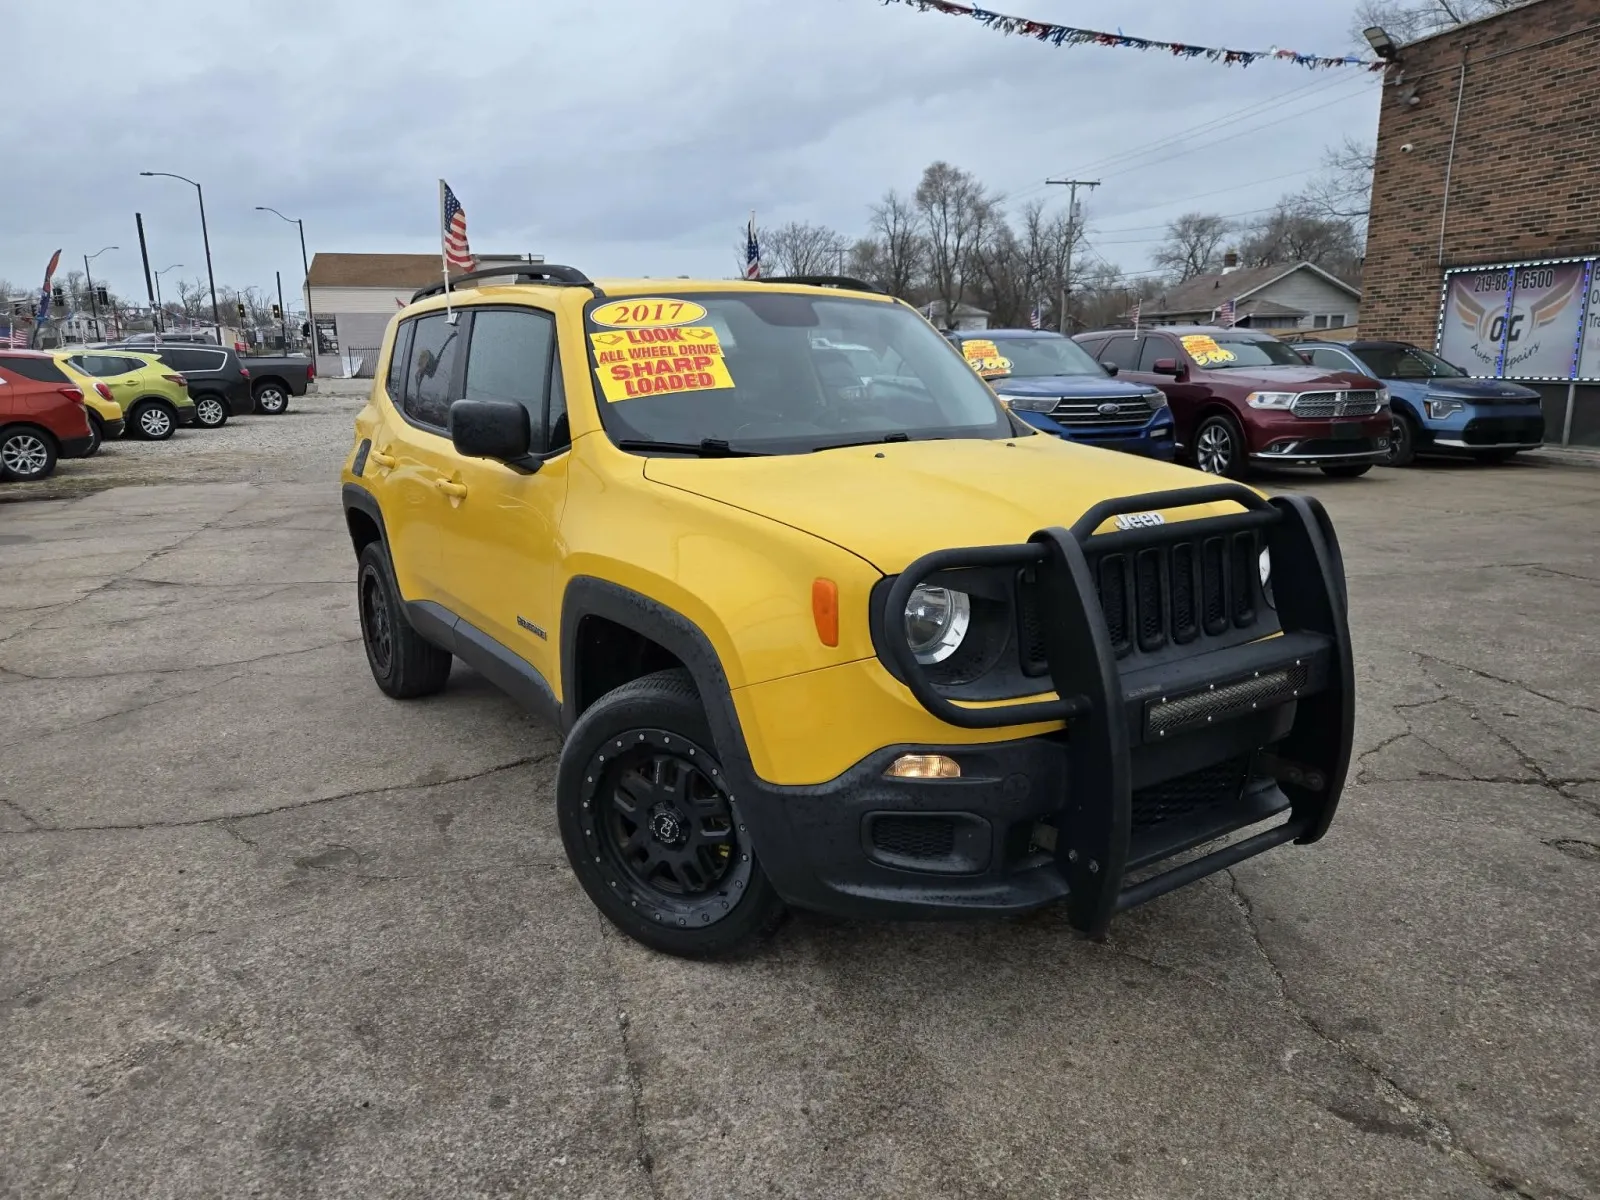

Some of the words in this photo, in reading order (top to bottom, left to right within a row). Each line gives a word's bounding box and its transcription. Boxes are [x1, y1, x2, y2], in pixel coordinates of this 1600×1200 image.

[1475, 269, 1554, 293] 219-88-6500
[613, 303, 684, 324] 2017
[626, 328, 687, 345] LOOK
[599, 349, 628, 364] ALL
[628, 345, 676, 360] WHEEL
[678, 344, 719, 356] DRIVE
[610, 356, 714, 381] SHARP
[624, 372, 716, 397] LOADED
[1114, 511, 1165, 530] Jeep
